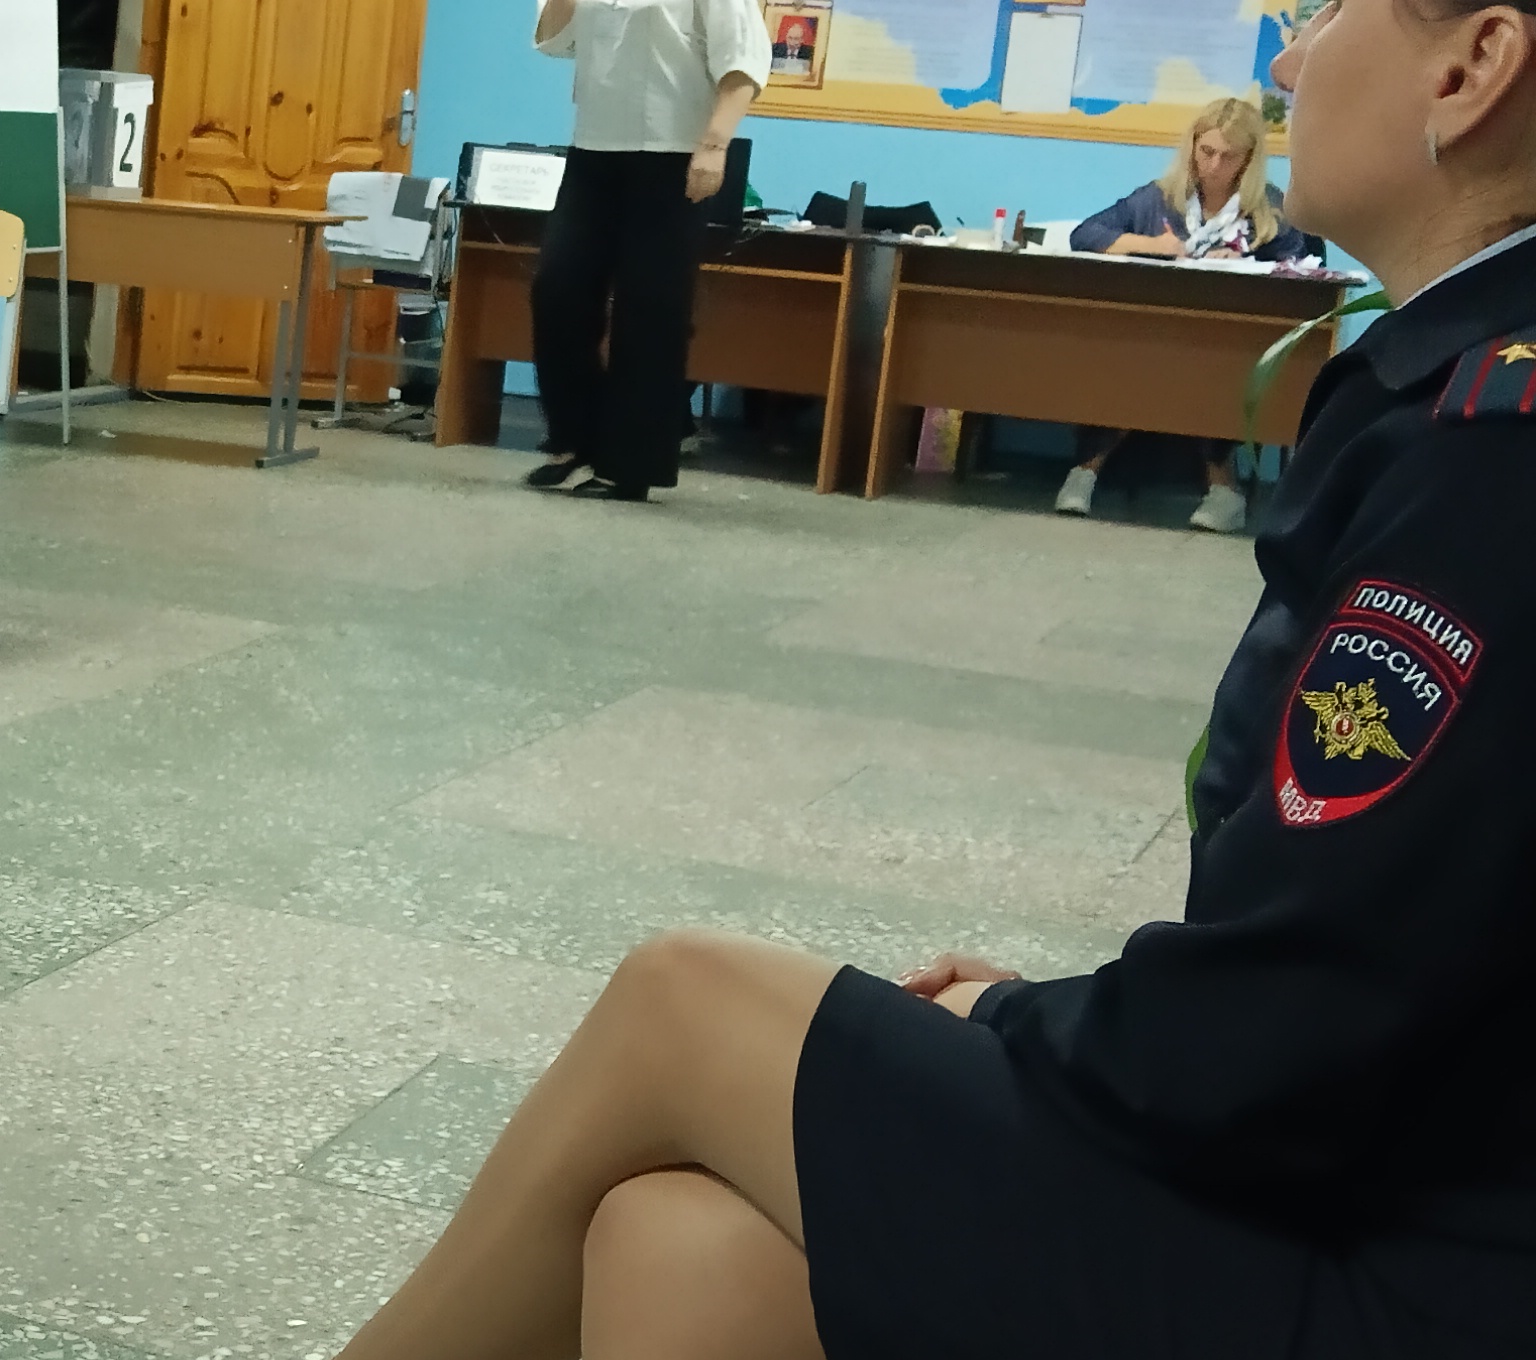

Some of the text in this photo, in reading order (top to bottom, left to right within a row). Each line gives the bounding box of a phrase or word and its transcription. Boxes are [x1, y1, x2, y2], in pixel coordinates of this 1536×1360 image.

[119, 112, 136, 173] 2
[1353, 587, 1474, 665] ПОЛИЦИЯ
[1329, 632, 1442, 712] РОССИЯ
[1279, 776, 1326, 823] МВД
